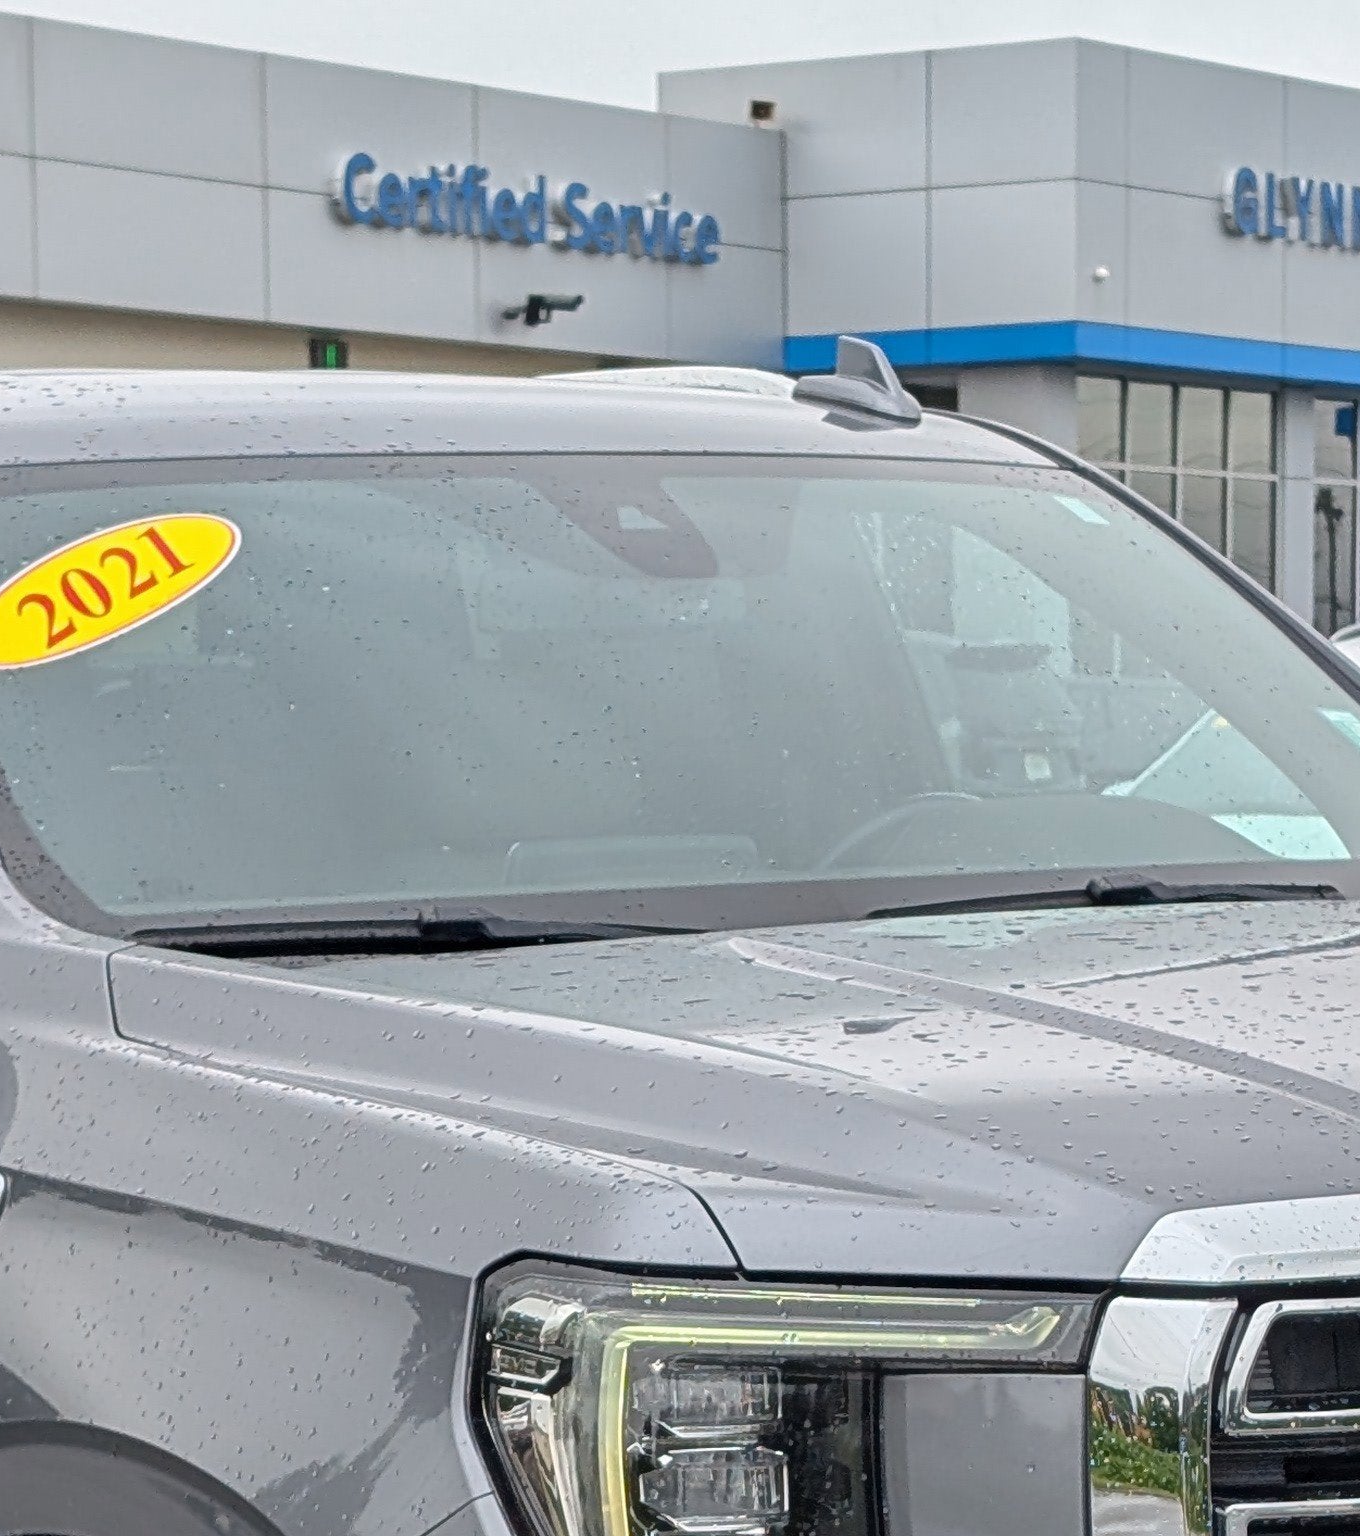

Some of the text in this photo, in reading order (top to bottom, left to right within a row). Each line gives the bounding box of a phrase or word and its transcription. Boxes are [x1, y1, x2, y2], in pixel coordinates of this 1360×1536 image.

[341, 151, 721, 266] Certified Service
[17, 526, 196, 648] 2021
